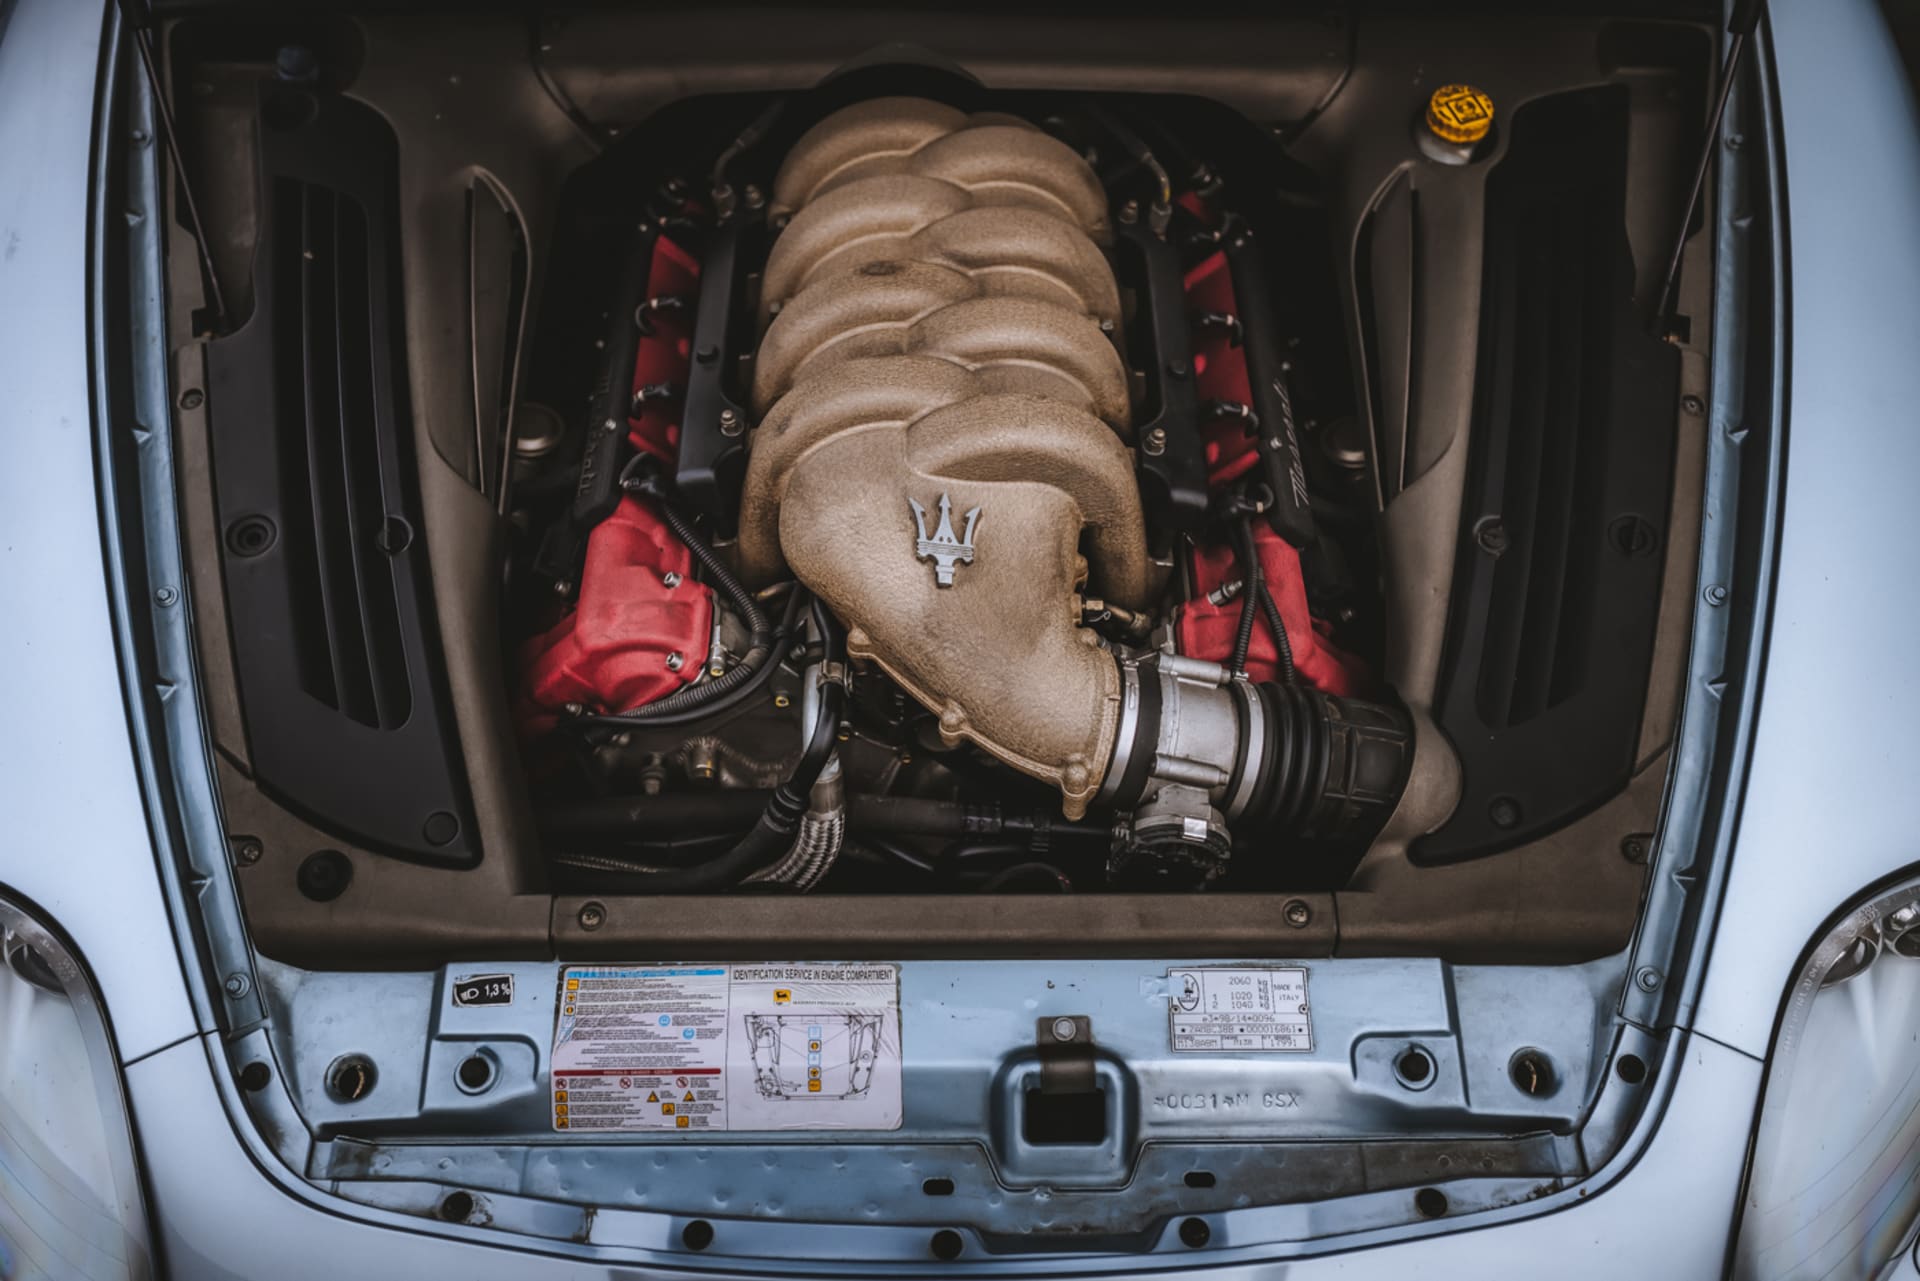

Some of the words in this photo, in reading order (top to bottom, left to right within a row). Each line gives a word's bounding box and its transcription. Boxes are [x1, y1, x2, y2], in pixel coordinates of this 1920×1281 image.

[733, 968, 783, 980] IDENTIFICATION
[785, 968, 812, 980] SERVICE
[821, 970, 845, 980] ENGINE
[846, 969, 893, 980] COMPARTMENT
[1229, 976, 1252, 985] 2060
[1231, 991, 1253, 1000] 1020
